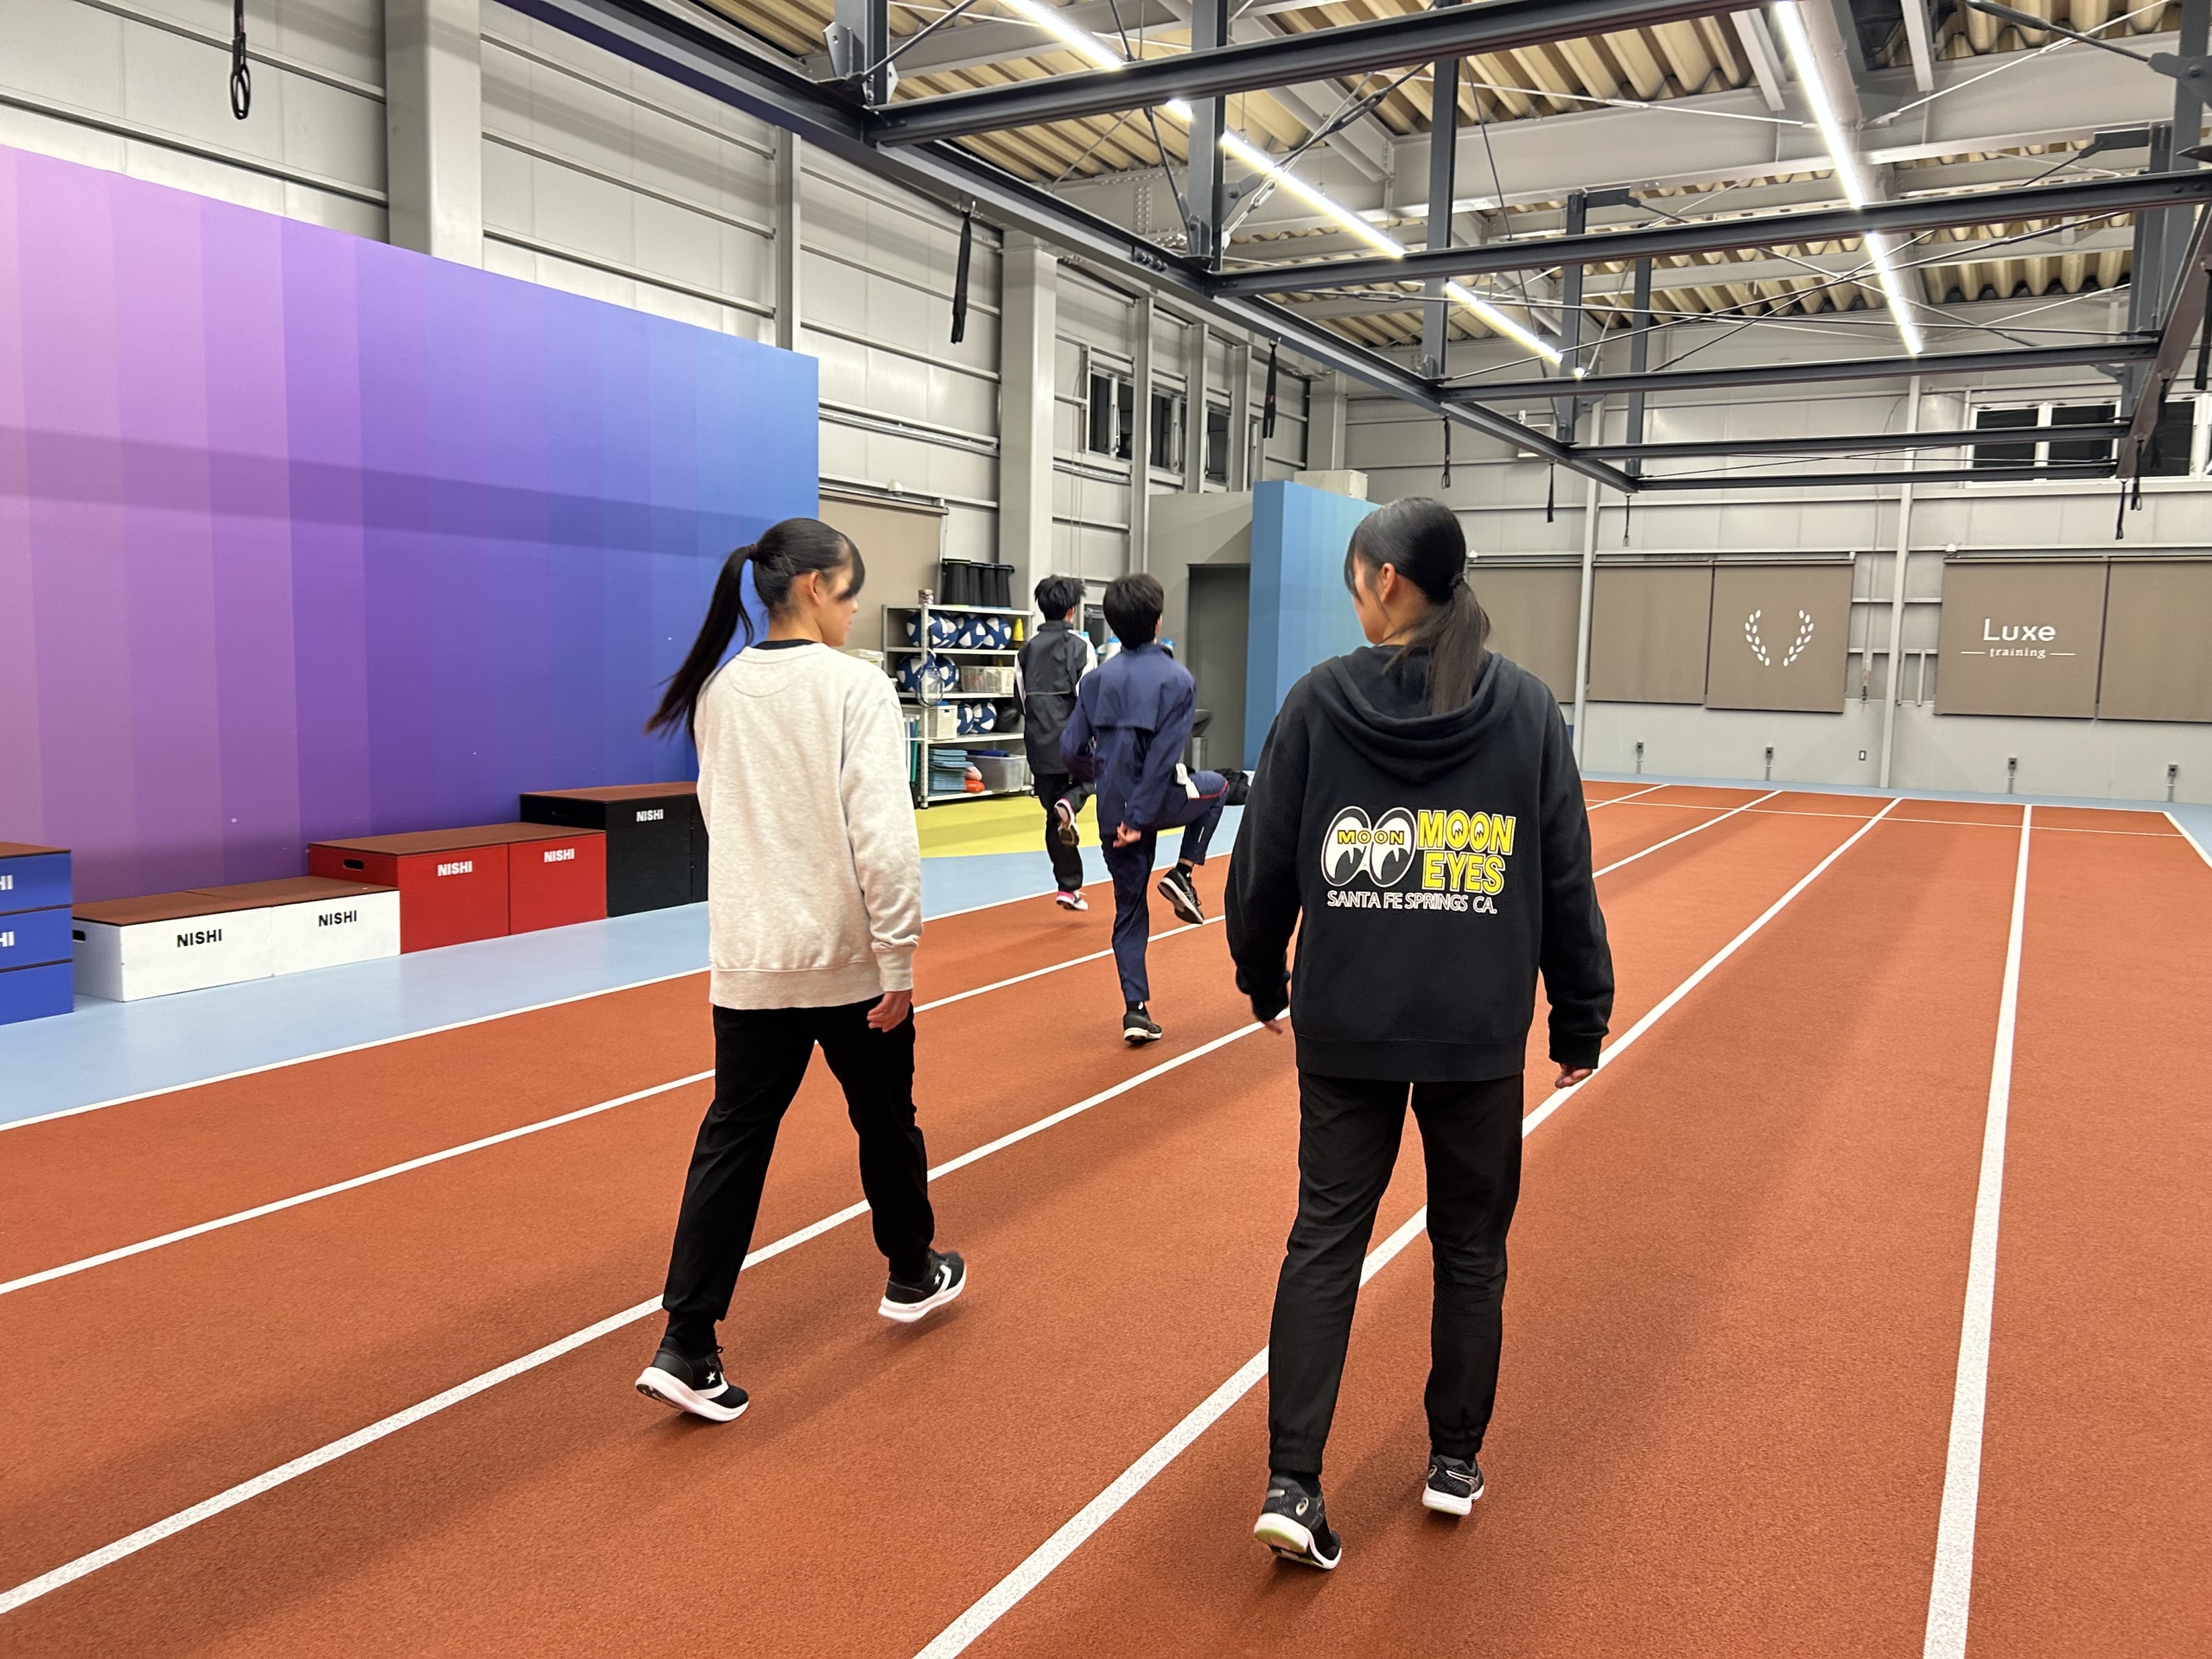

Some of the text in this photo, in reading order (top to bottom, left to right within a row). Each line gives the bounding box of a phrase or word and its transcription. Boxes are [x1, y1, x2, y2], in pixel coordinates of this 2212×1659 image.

[1983, 618, 2056, 641] Luxe
[1990, 647, 2046, 658] training
[636, 809, 664, 822] NISHI
[1337, 830, 1405, 845] MOON
[1416, 809, 1516, 855] MOON
[543, 848, 575, 863] NISHI
[437, 861, 473, 877] NISHI
[1421, 849, 1506, 896] EYES
[1327, 890, 1497, 914] SANTA FE SPRINGS CA.
[318, 910, 358, 927] NISHI
[176, 928, 223, 948] NISHI
